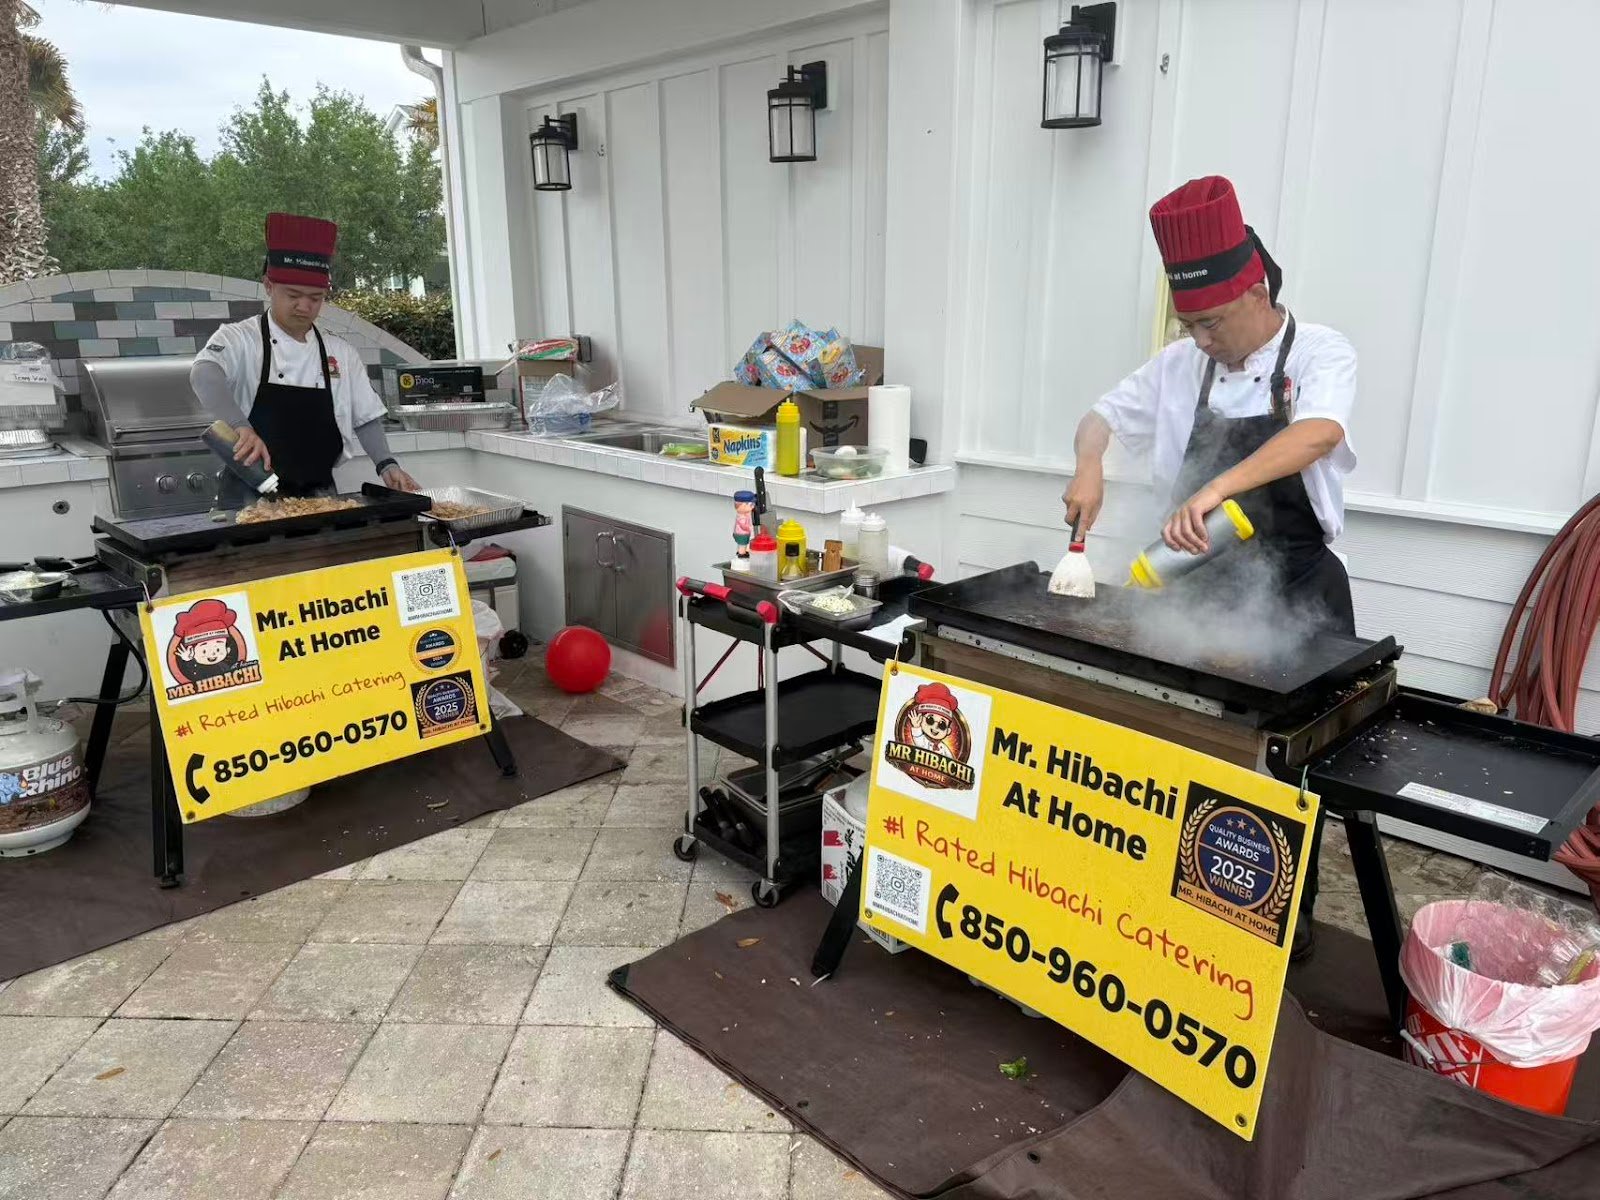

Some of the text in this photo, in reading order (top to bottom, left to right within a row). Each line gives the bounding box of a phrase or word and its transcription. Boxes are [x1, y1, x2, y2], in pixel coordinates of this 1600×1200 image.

[1182, 269, 1208, 280] home
[723, 434, 761, 455] Napkins
[255, 609, 294, 632] Mr.
[298, 587, 389, 623] Hibachi
[278, 624, 381, 662] At Home
[167, 664, 260, 699] MR HIBACHI
[432, 693, 457, 704] AWARDS
[174, 671, 406, 738] #1 Rated Hibachi Catering
[434, 702, 459, 716] 2025
[212, 709, 408, 783] 850-960-0570
[888, 742, 972, 783] MR HIBACHI
[19, 765, 81, 798] Rhino
[22, 755, 73, 781] Blue
[909, 765, 946, 783] AT HOME
[992, 727, 1179, 820] Mr. Hibachi
[1002, 781, 1148, 861] At Home
[1208, 823, 1271, 854] QUALITY BUSINESS
[1215, 836, 1260, 862] AWARDS
[1209, 872, 1254, 901] WINNER
[1210, 855, 1256, 889] 2025
[883, 815, 904, 839] #1
[915, 819, 996, 877] Rated
[1008, 861, 1104, 926] Hibachi
[1116, 912, 1254, 1021] Catering
[1178, 884, 1278, 937] MR. HIBACHI AT HOME
[959, 904, 1258, 1089] 850-960-0570
